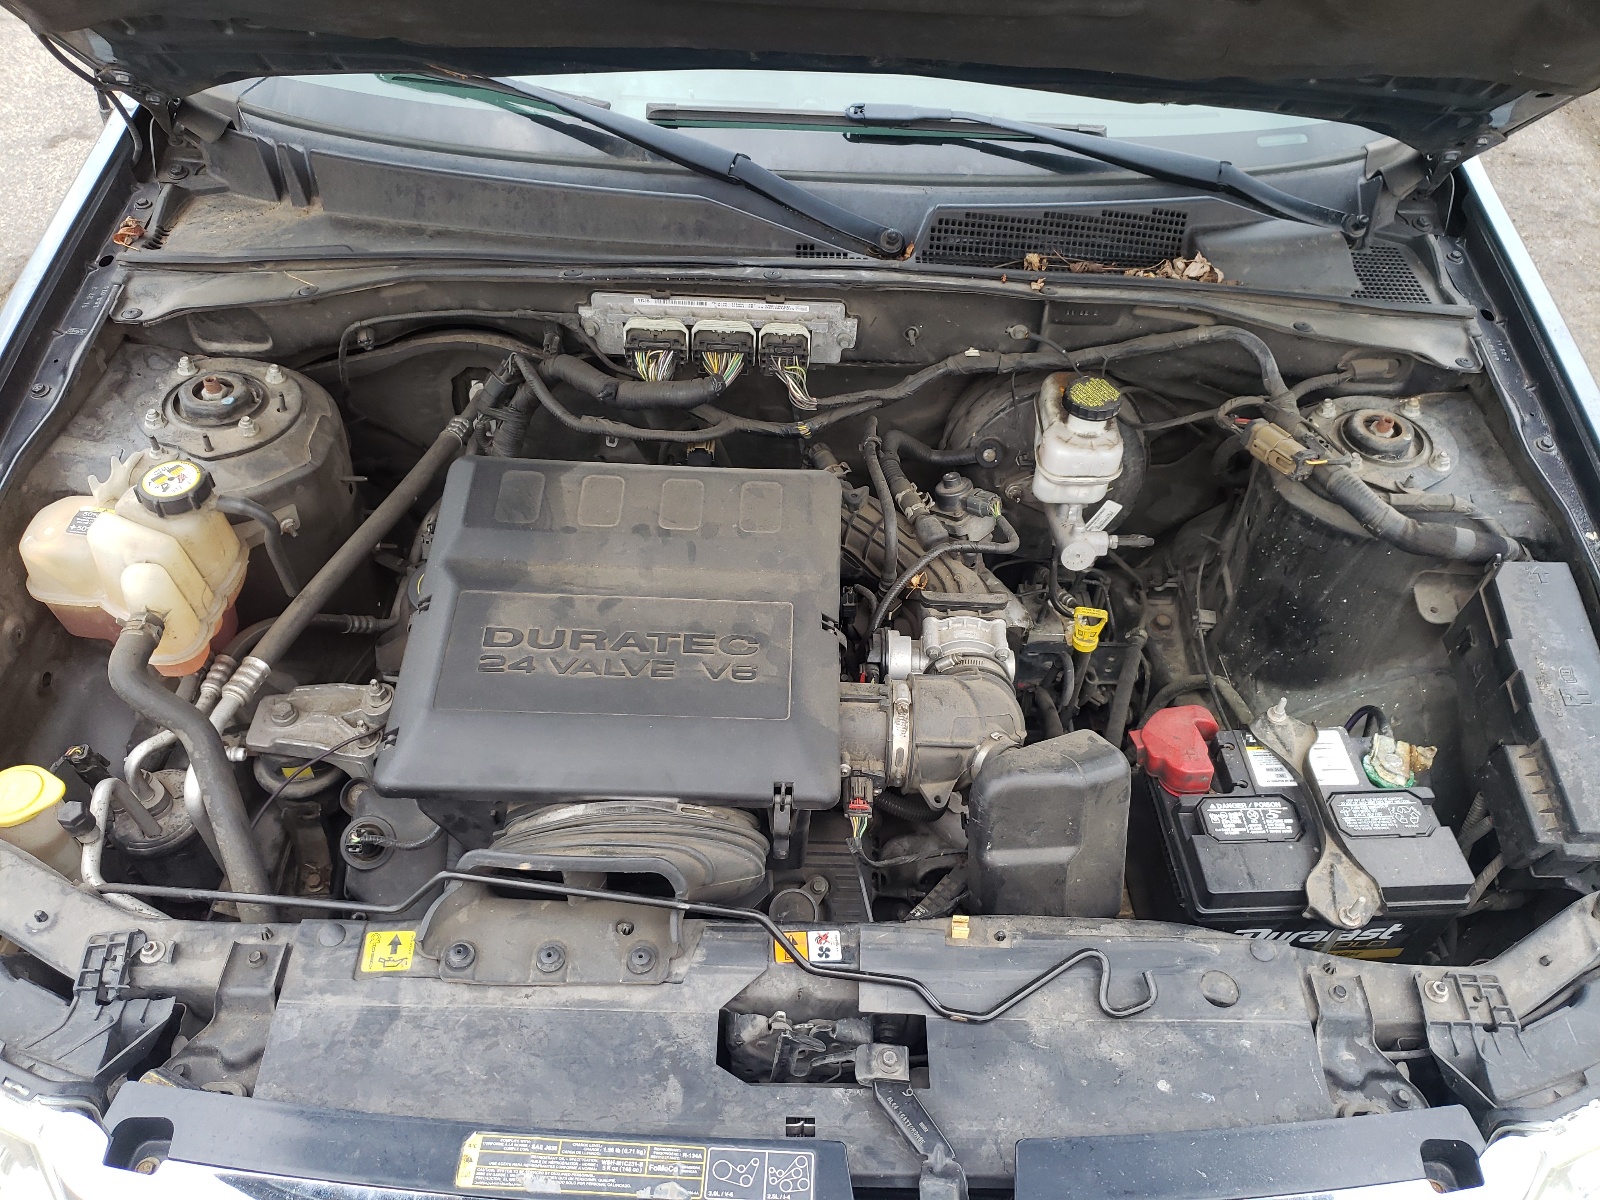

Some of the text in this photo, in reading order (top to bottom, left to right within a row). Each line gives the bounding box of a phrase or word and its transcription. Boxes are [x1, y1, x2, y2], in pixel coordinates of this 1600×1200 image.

[482, 626, 761, 656] DURATEC
[477, 654, 758, 681] 24 VALVE V6
